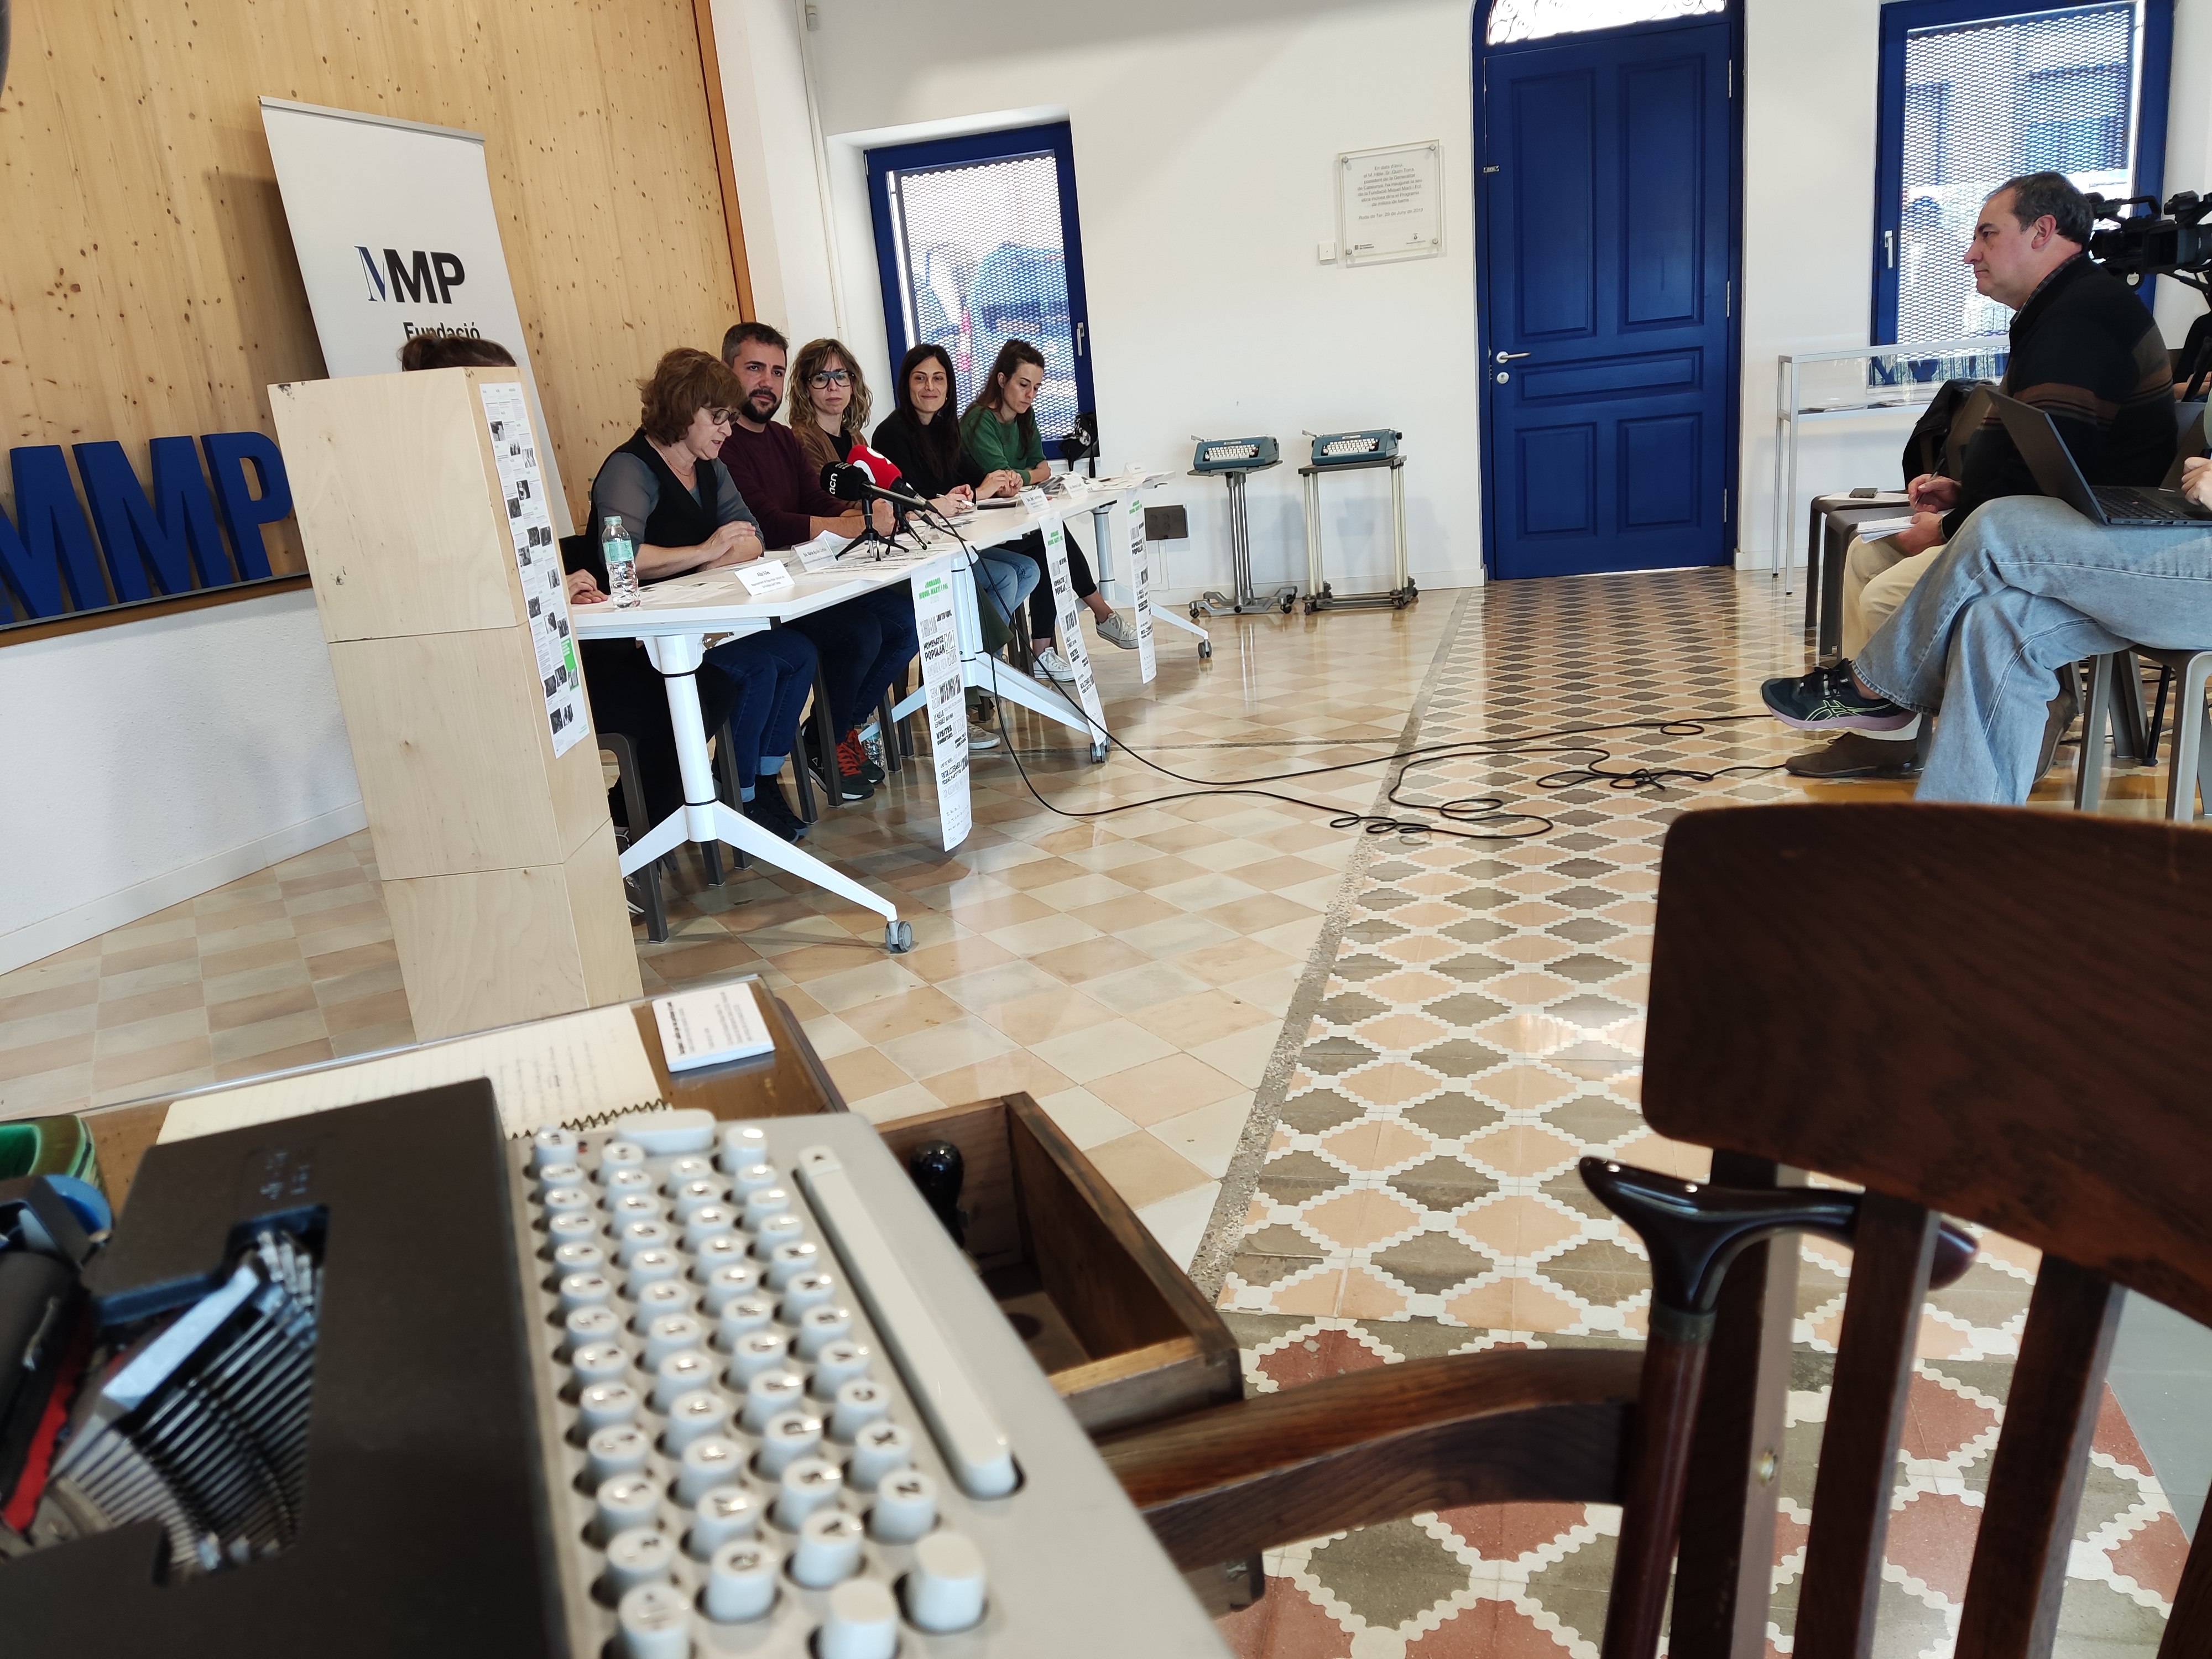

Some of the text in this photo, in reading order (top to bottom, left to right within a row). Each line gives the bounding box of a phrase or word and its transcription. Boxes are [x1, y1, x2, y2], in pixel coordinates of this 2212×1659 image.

[830, 473, 838, 494] acn
[924, 635, 944, 651] HOMENATGE
[925, 644, 946, 662] POPULAR
[936, 724, 952, 739] VISITES
